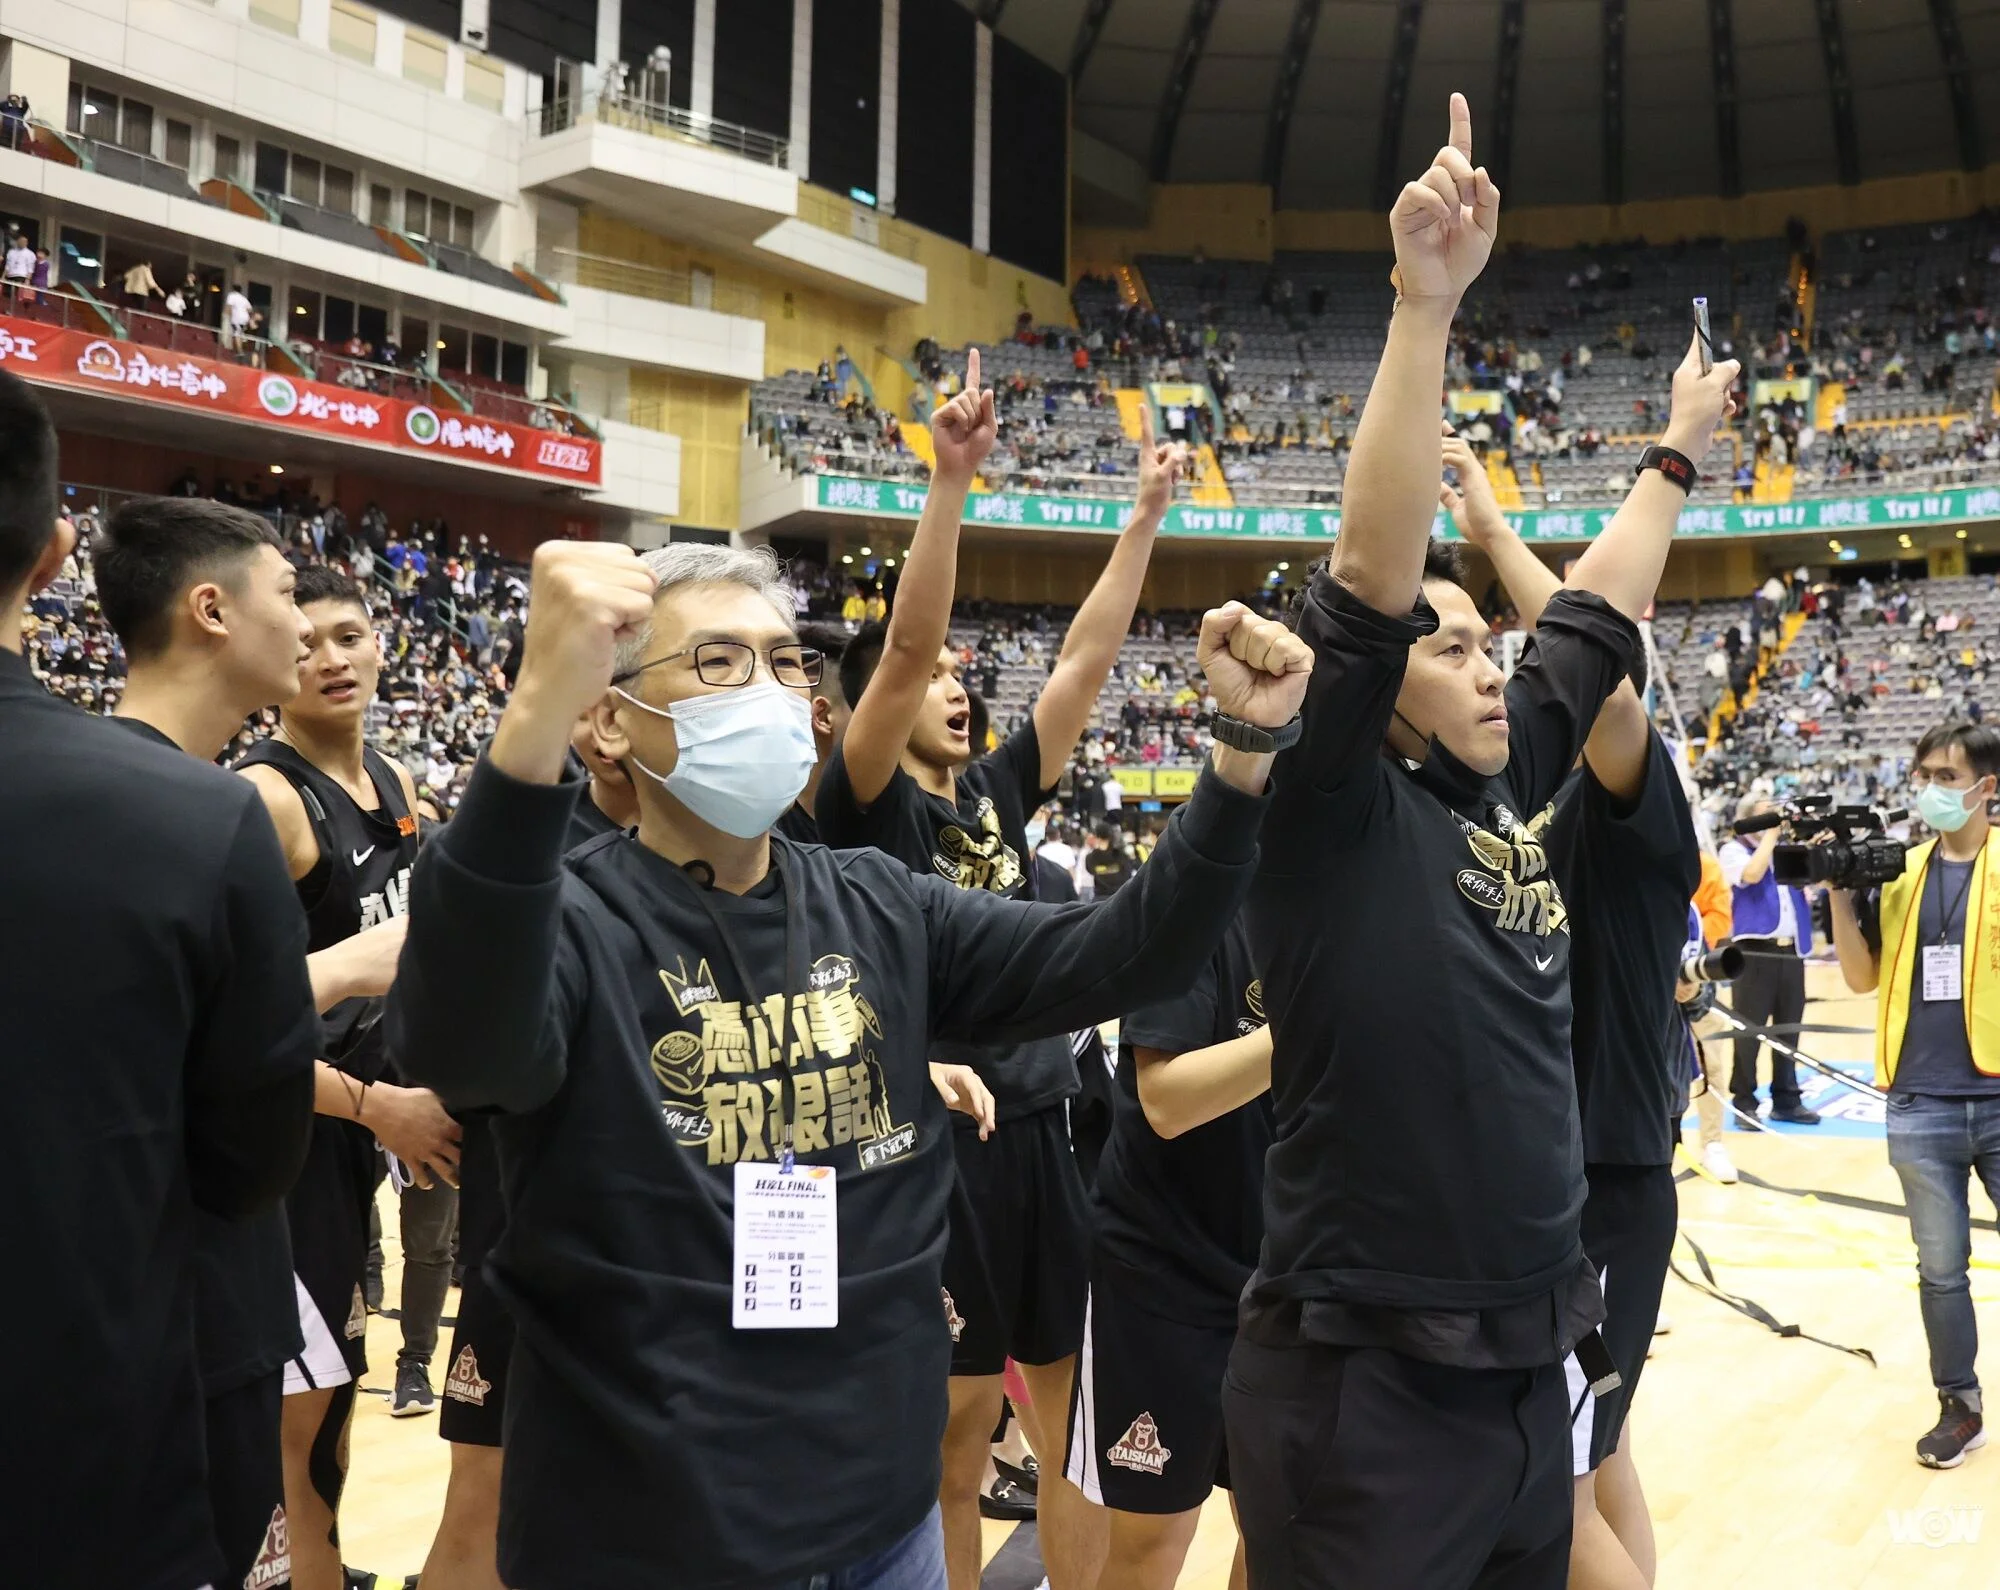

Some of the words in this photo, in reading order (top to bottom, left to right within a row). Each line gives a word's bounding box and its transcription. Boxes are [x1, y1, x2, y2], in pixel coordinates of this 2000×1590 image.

[127, 352, 227, 400] 永仁高中
[298, 389, 381, 429] 北一女中
[1039, 501, 1074, 523] Try
[1180, 509, 1215, 531] Try
[1740, 508, 1775, 528] Try
[1884, 499, 1921, 520] Try
[1459, 871, 1505, 904] 從你手上
[809, 962, 852, 987] 不就為了
[662, 1107, 712, 1138] 你手上
[702, 1063, 876, 1166] 放狠話
[862, 1129, 916, 1166] 拿下冠軍
[787, 1180, 819, 1192] FINAL
[1114, 1445, 1163, 1468] TAISHAN
